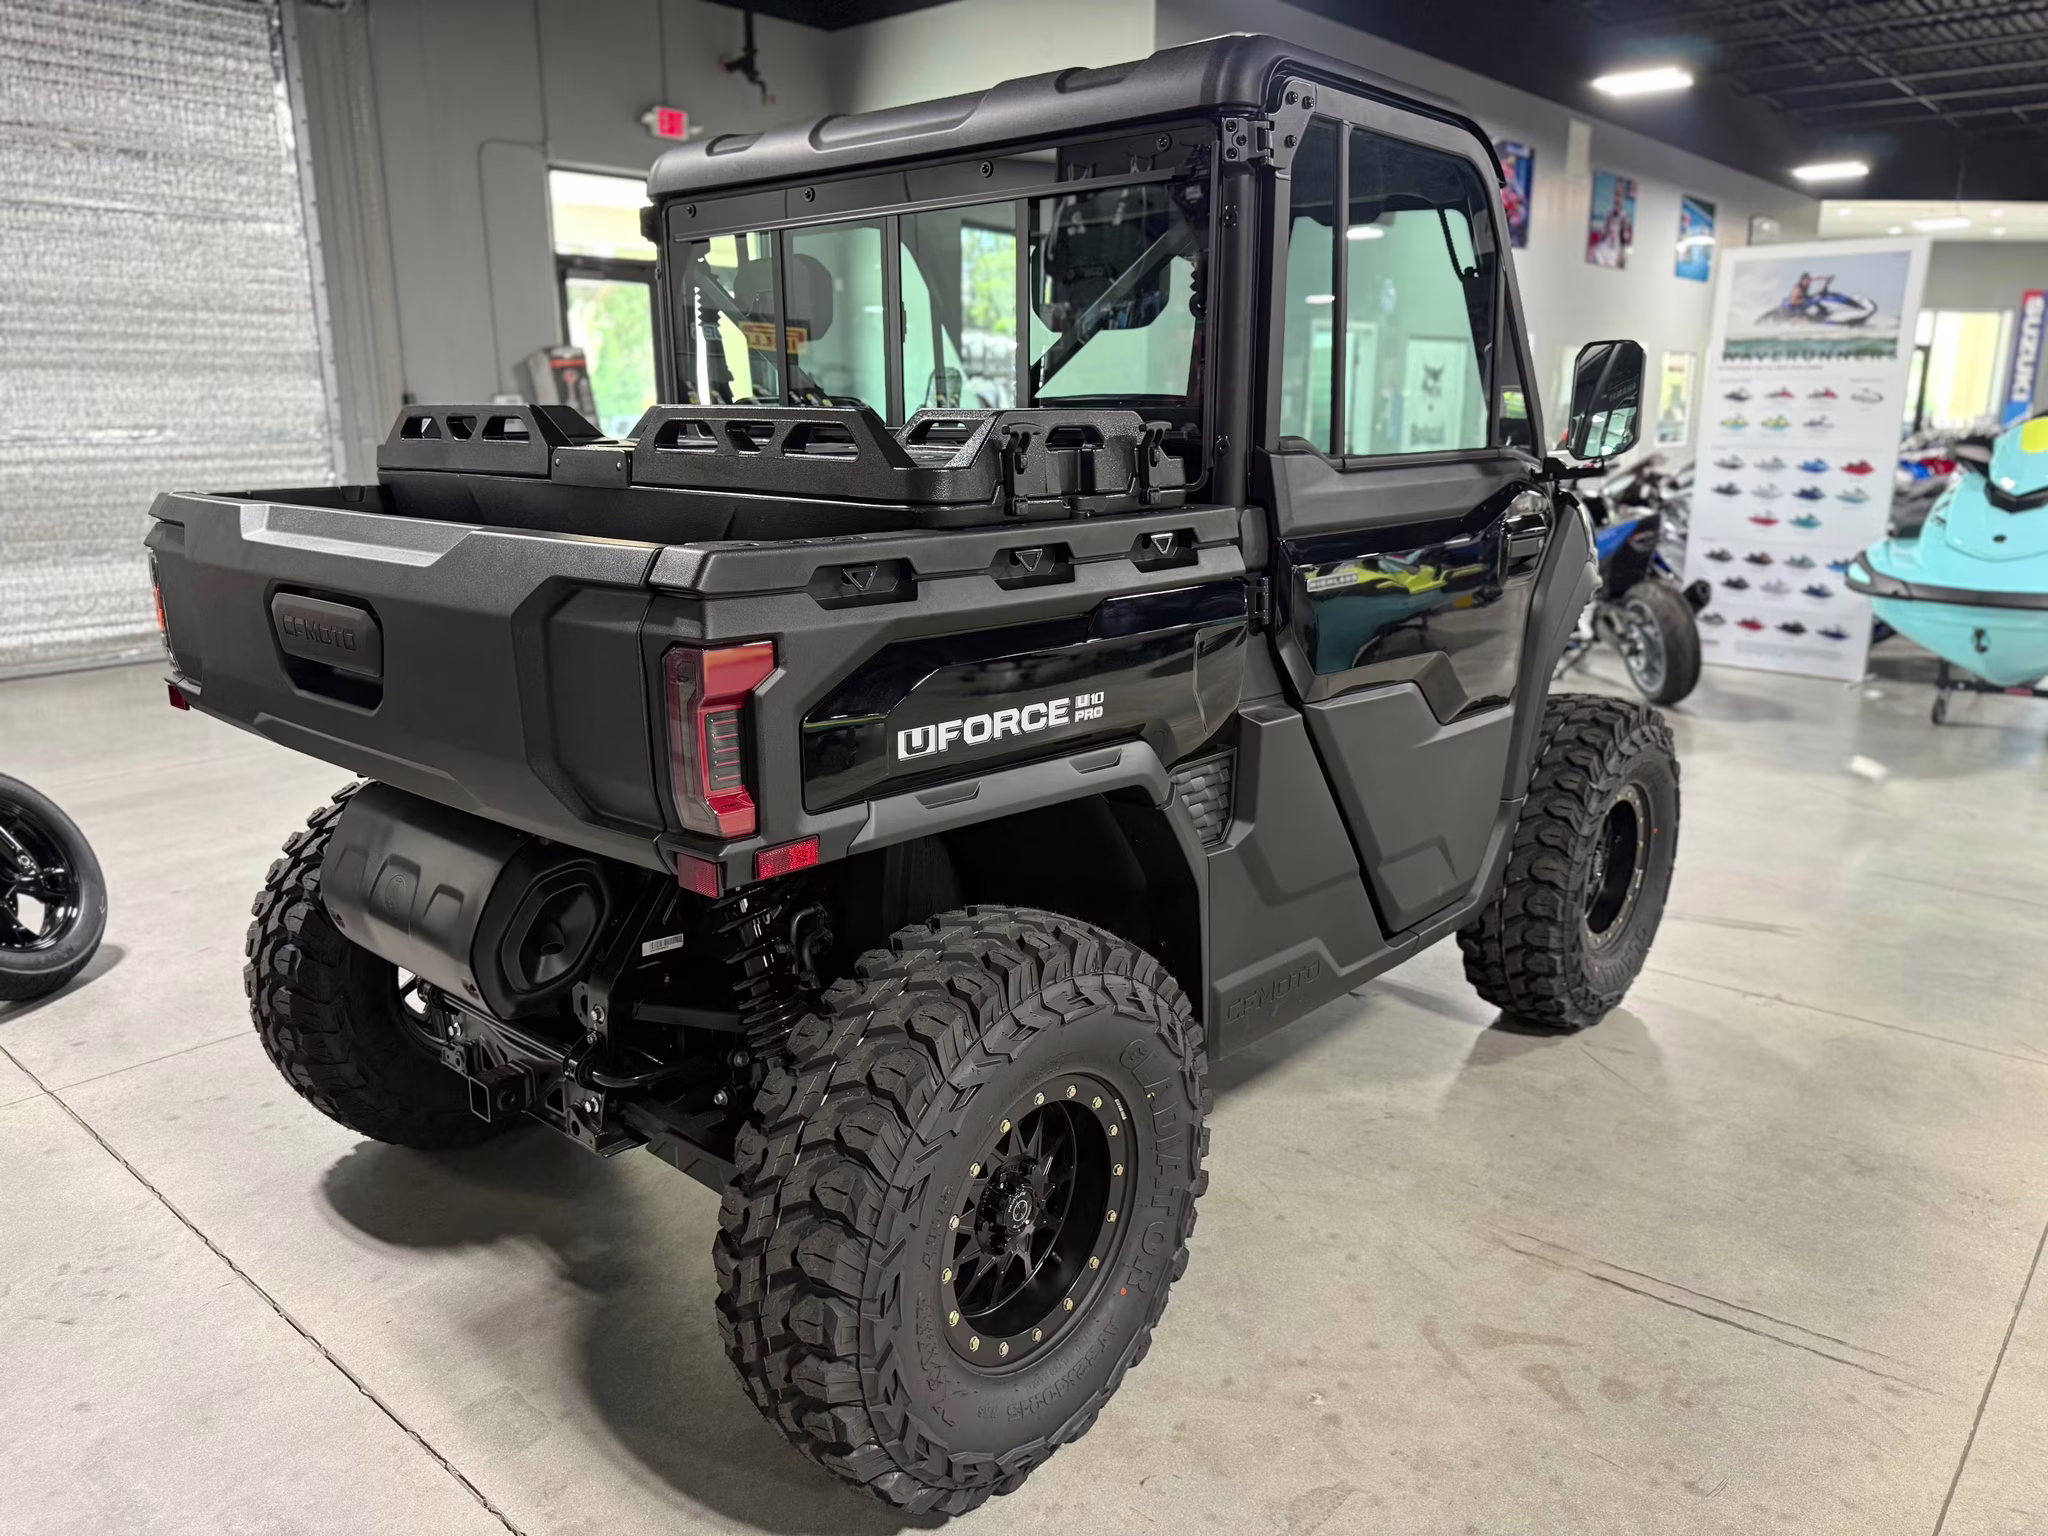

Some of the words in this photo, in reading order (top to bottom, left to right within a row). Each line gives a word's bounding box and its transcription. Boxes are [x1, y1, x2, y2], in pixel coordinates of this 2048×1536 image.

[2011, 295, 2045, 402] SUZUKI
[283, 615, 356, 651] CFMOTO
[898, 697, 1070, 761] UFORCE
[1074, 705, 1104, 723] PRO
[1226, 960, 1320, 1025] CFMOTO
